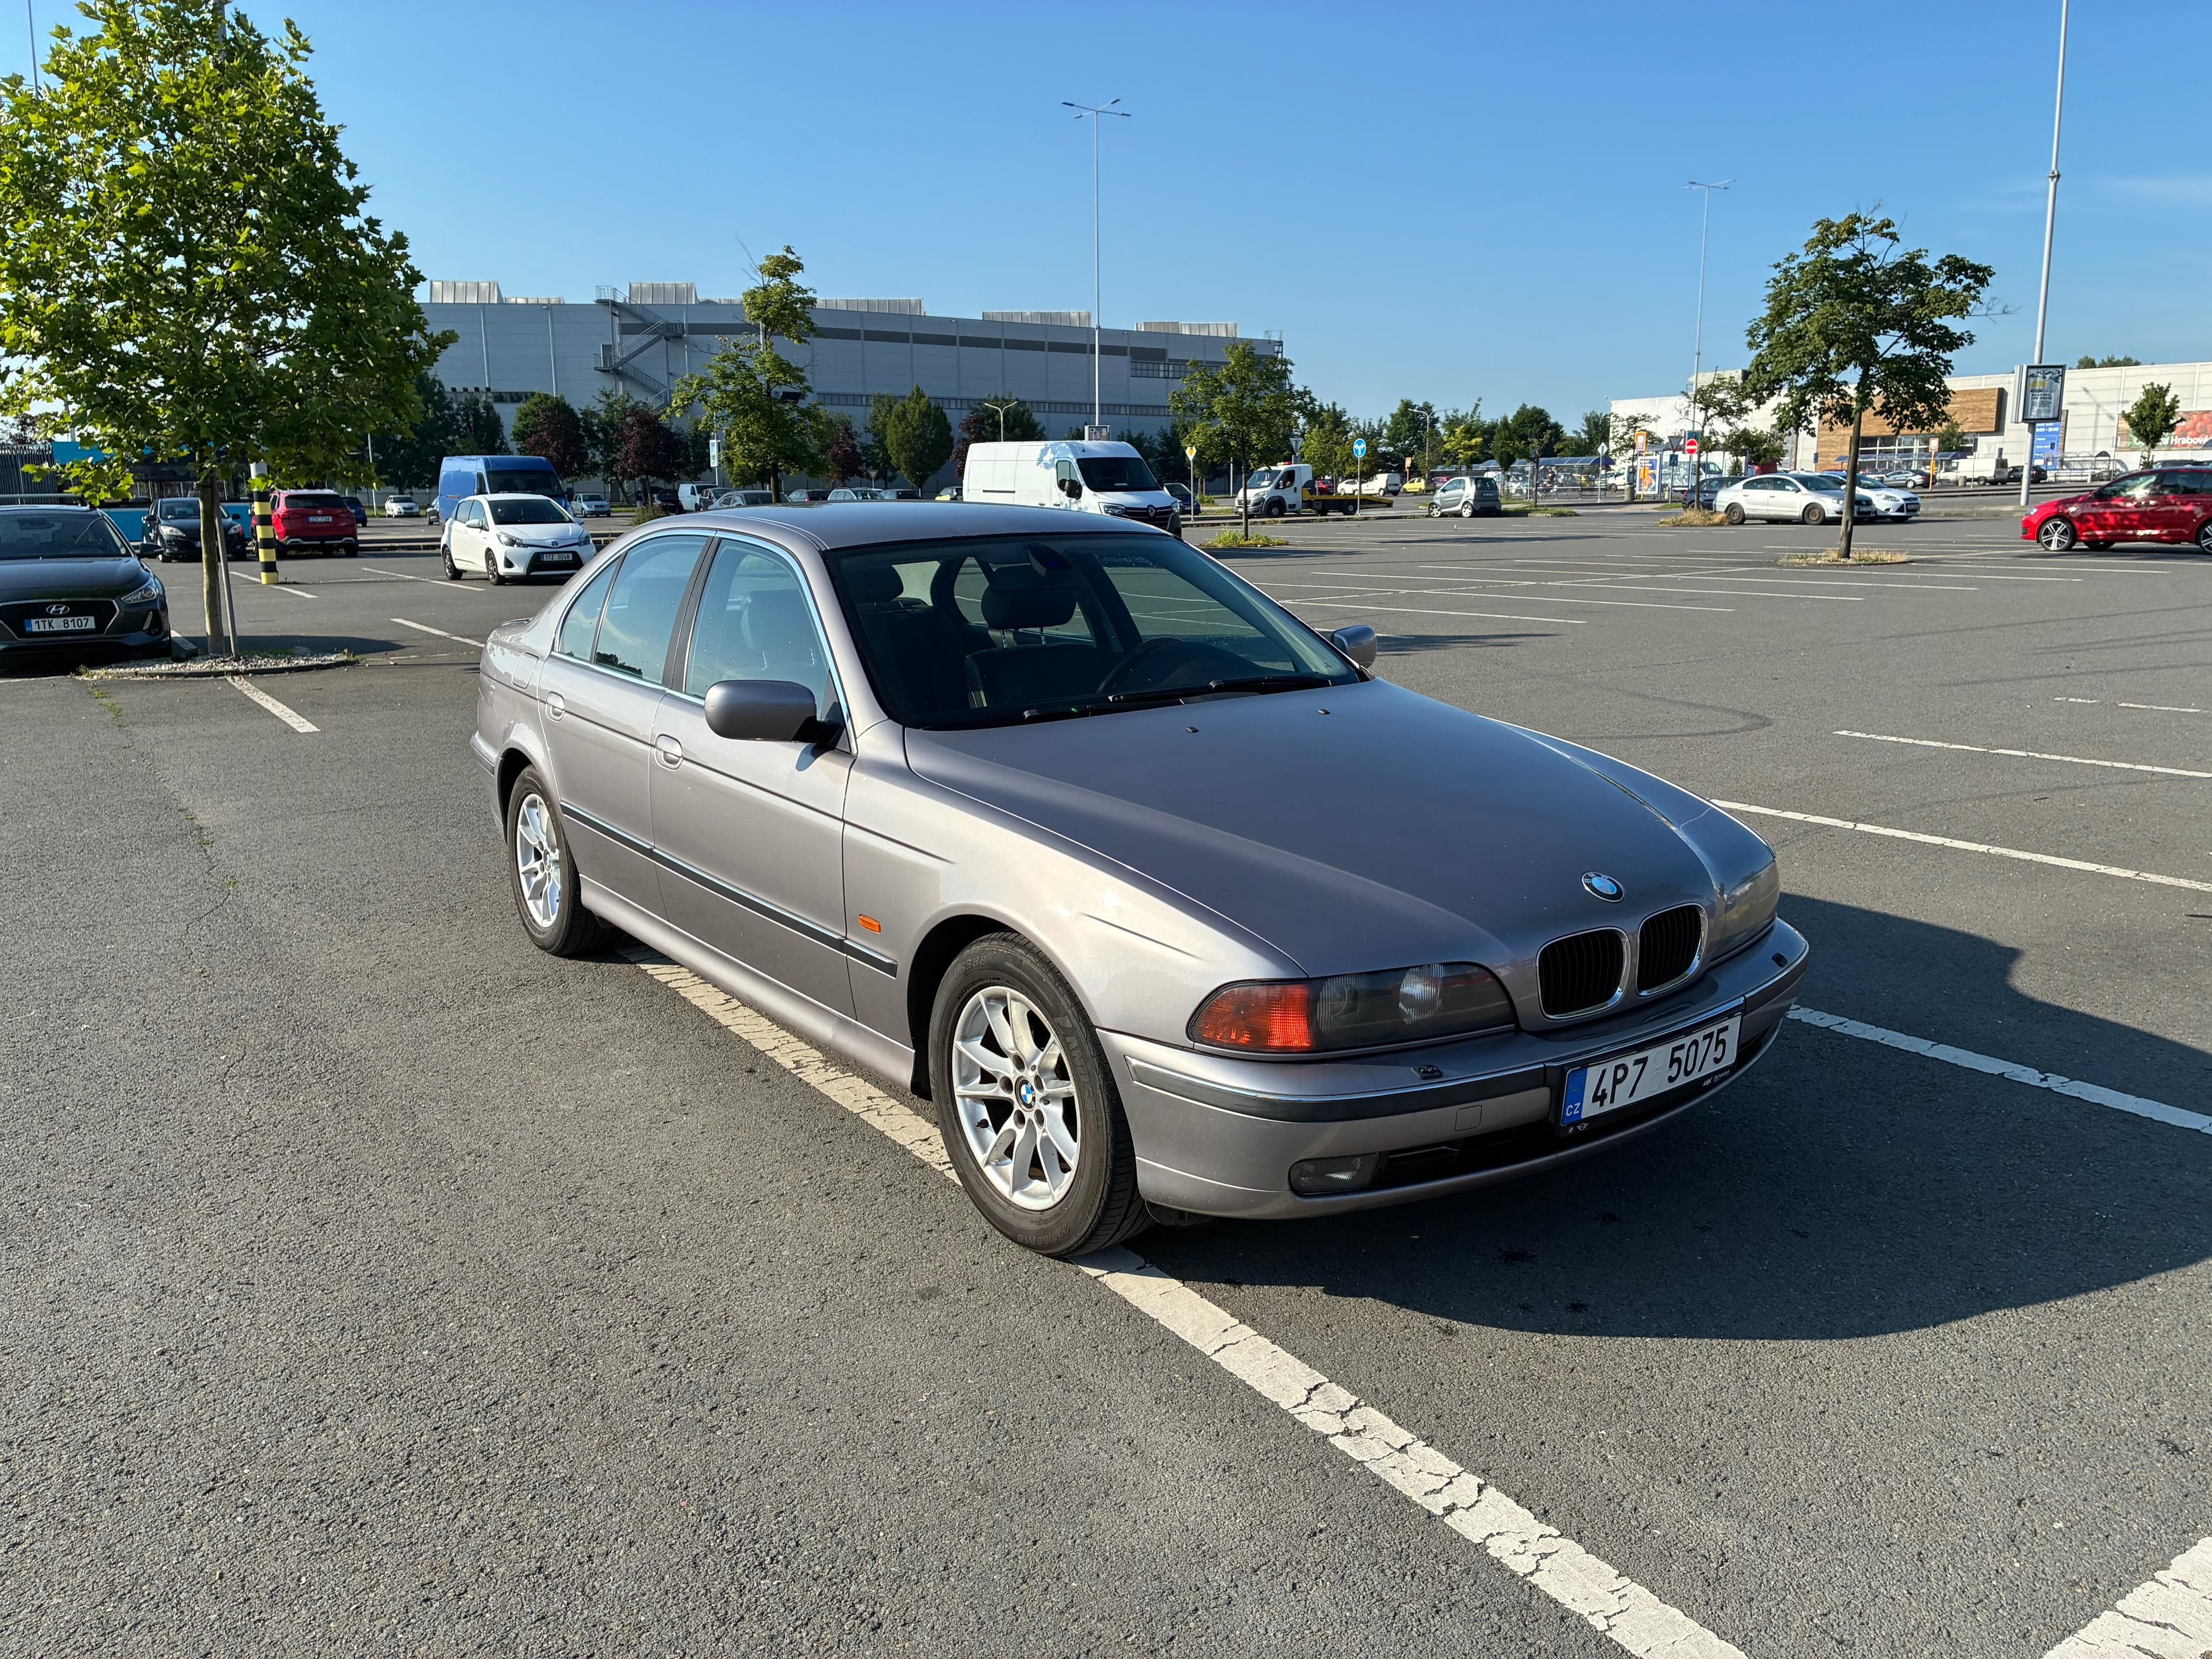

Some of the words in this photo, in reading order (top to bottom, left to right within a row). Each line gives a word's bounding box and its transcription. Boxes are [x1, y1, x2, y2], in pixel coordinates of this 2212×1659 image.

[35, 619, 54, 630] 1TK
[63, 618, 89, 629] 8107
[1592, 1056, 1648, 1107] 4P7
[1668, 1025, 1729, 1083] 5075
[1566, 1102, 1581, 1116] CZ
